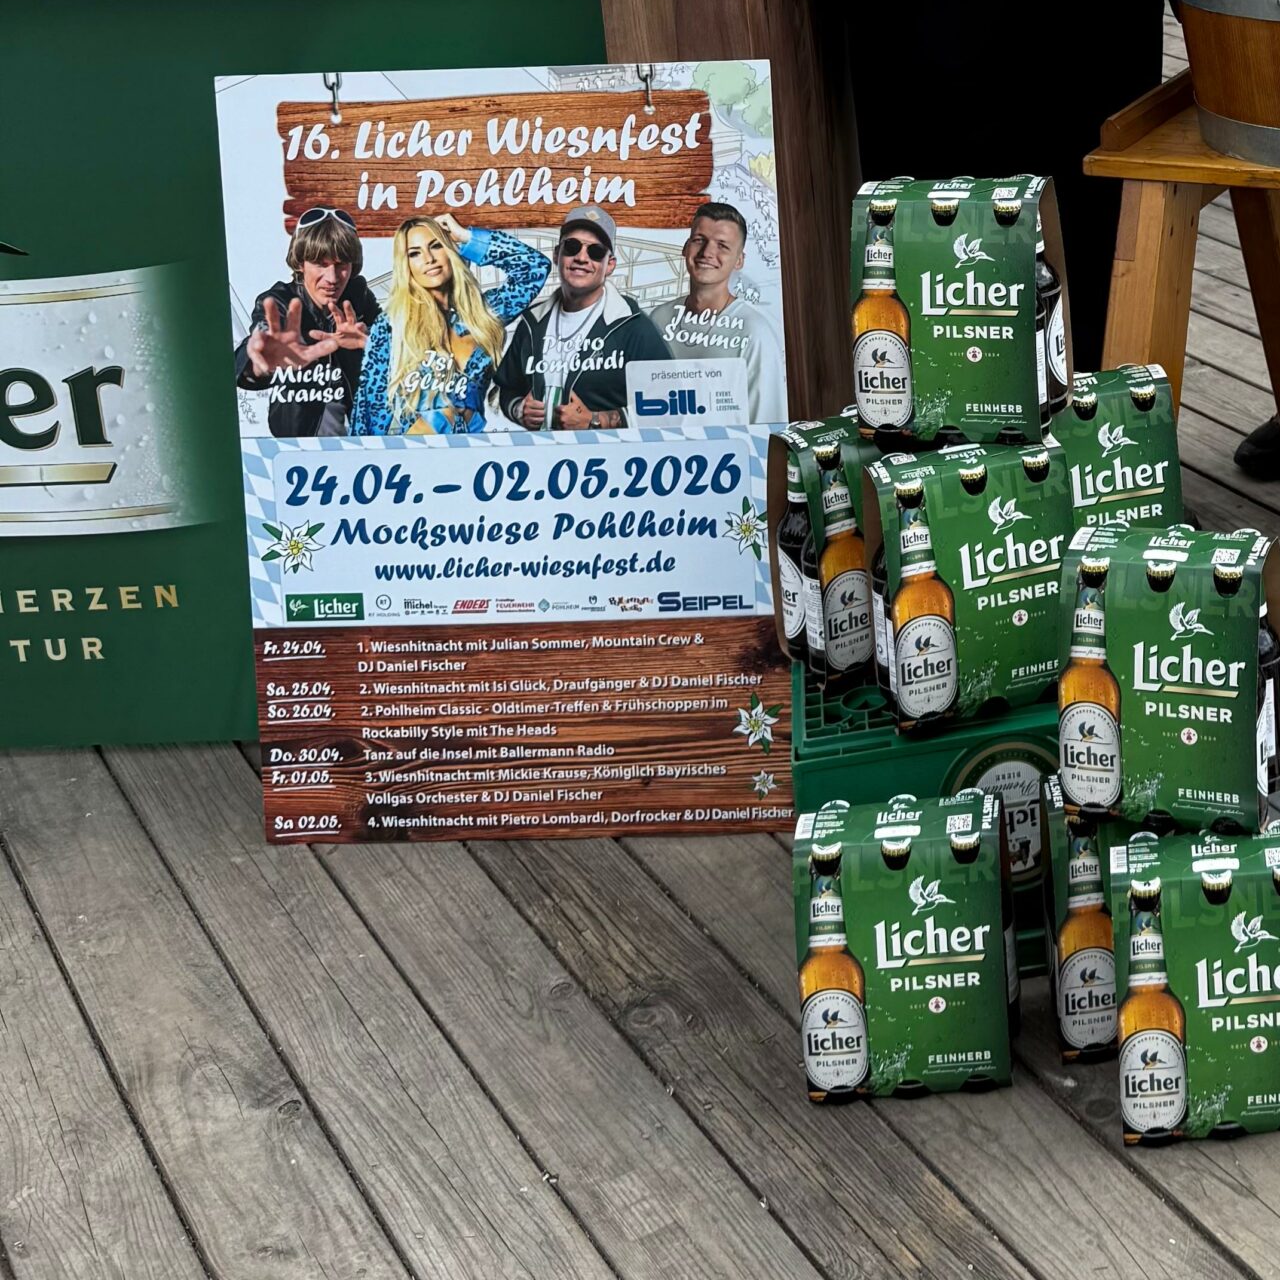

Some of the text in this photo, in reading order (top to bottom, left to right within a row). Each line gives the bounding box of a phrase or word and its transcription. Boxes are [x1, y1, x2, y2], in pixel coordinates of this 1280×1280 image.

[286, 113, 702, 161] 16. Licher Wiesnfest
[357, 166, 637, 210] in Pohlheim
[920, 270, 1024, 316] Licher
[671, 304, 744, 330] Julian
[662, 325, 751, 350] Sommer
[933, 325, 1014, 340] PILSNER
[542, 335, 605, 355] Pietro
[422, 350, 453, 371] Isi
[525, 350, 625, 375] Lombardi
[270, 366, 342, 386] Mickie
[405, 371, 468, 400] Glück
[651, 370, 702, 381] präsentiert
[858, 370, 907, 393] Licher
[270, 385, 345, 404] Krause
[635, 389, 706, 417] bill.
[866, 398, 903, 406] PILSNER
[966, 403, 1023, 413] FEINHERB
[473, 453, 742, 502] 02.05.2026
[1070, 456, 1169, 508] Licher
[1086, 503, 1163, 526] PILSNER
[330, 508, 718, 551] Mockswiese Pohlheim
[375, 550, 676, 581] www.licher-wiesnfest.de
[958, 533, 1065, 590] Licher
[0, 584, 179, 614] ERZEN
[453, 599, 492, 610] ENDERS
[657, 591, 754, 613] SEIPEL
[977, 580, 1059, 611] PILSNER
[313, 598, 360, 618] Licher
[263, 640, 326, 655] Fr. 24.04.
[357, 633, 705, 653] 1. Wiesnhitnacht mit Julian Sommer, Mountain Crew &
[358, 660, 467, 672] DJ Daniel Fischer
[1132, 641, 1247, 693] Licher
[266, 683, 290, 696] Sa.
[360, 674, 763, 695] 2. Wiesnhitnacht mit Isi Glück, Draufgänger & DJ Daniel Fischer
[268, 704, 336, 719] So. 26.04.
[361, 697, 728, 717] 2. Pohlheim Classic Oldtimer-Treffen & Frühschoppen im
[1145, 701, 1232, 724] PILSNER
[1063, 743, 1117, 768] Licher
[1178, 788, 1240, 804] FEINHERB
[874, 916, 991, 970] Licher
[890, 972, 981, 992] PILSNER
[928, 1051, 992, 1064] FEINHERB
